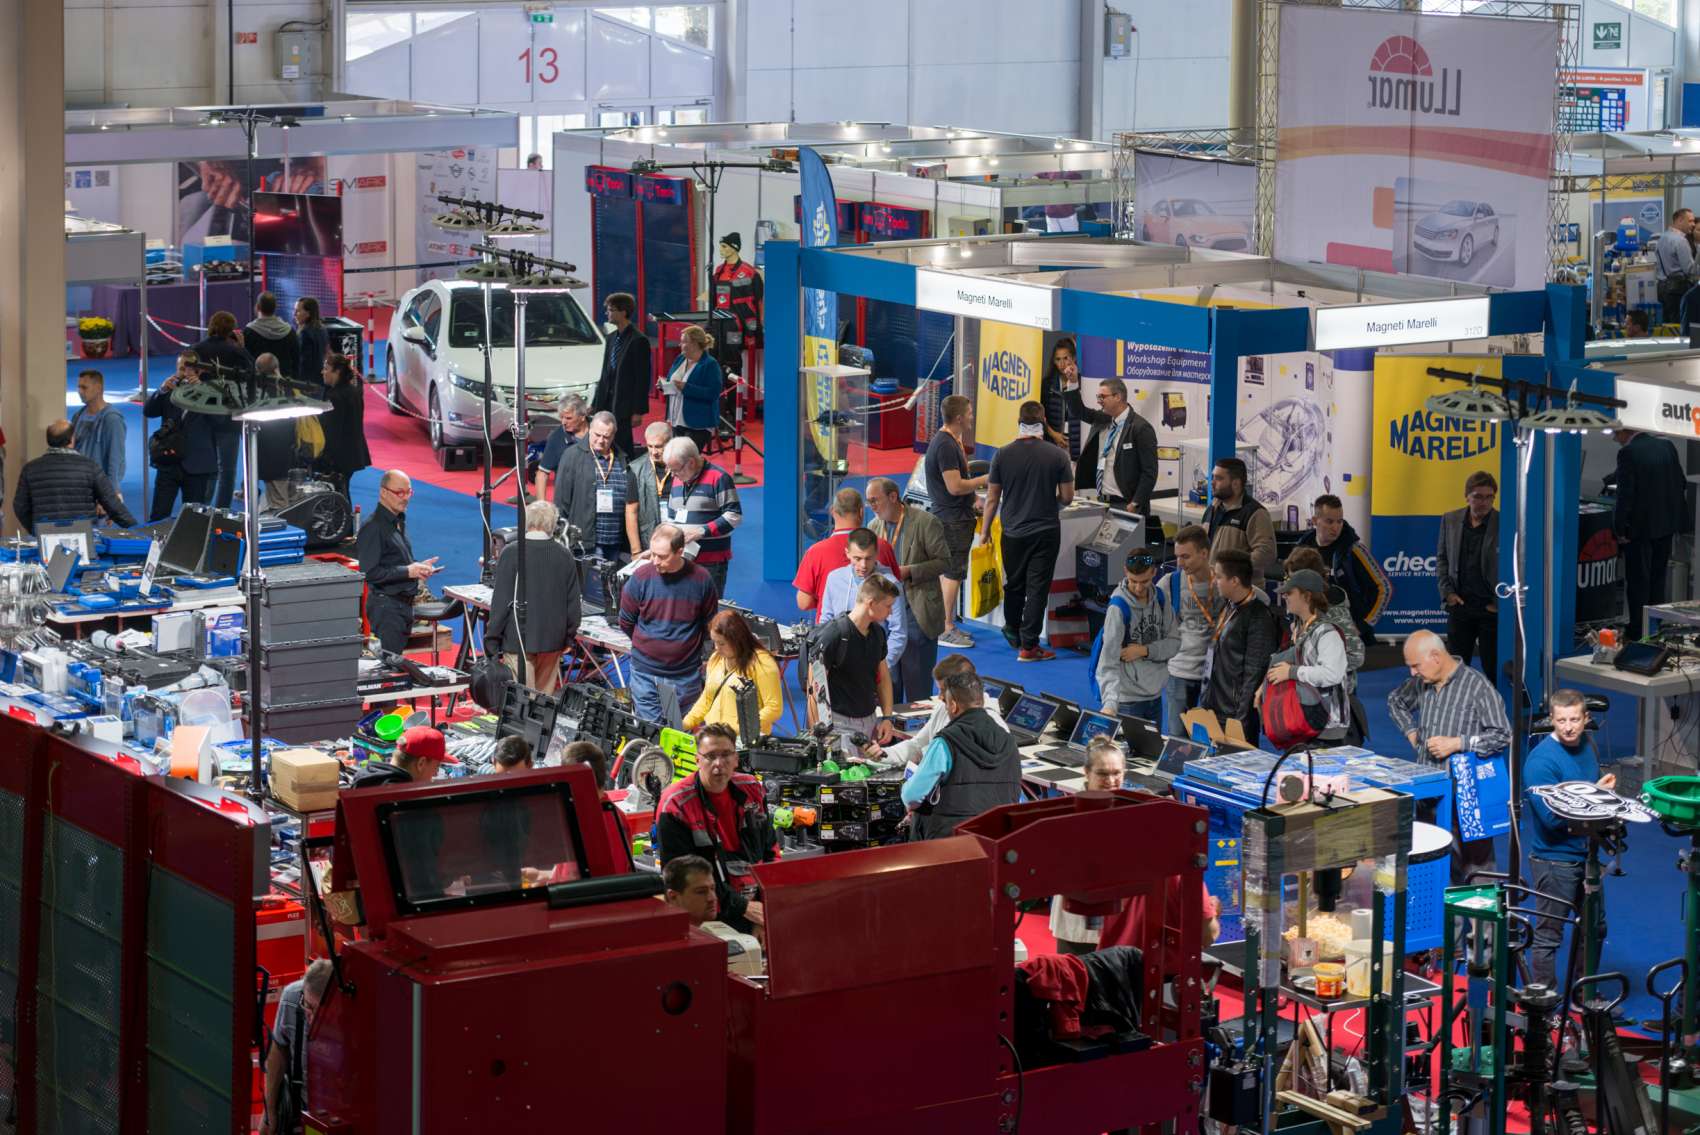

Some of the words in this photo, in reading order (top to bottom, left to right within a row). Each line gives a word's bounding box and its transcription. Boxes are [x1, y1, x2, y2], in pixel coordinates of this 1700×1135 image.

[518, 47, 560, 83] 13
[957, 289, 986, 304] Magneti
[988, 295, 1013, 309] Marelli
[1366, 320, 1404, 335] Magneti
[1406, 316, 1438, 329] Marelli
[983, 350, 1031, 383] MAGNETI
[1127, 354, 1166, 365] Workshop
[1166, 356, 1207, 368] Equipment
[983, 364, 1031, 401] MARELLI
[1390, 425, 1497, 461] MARELLI
